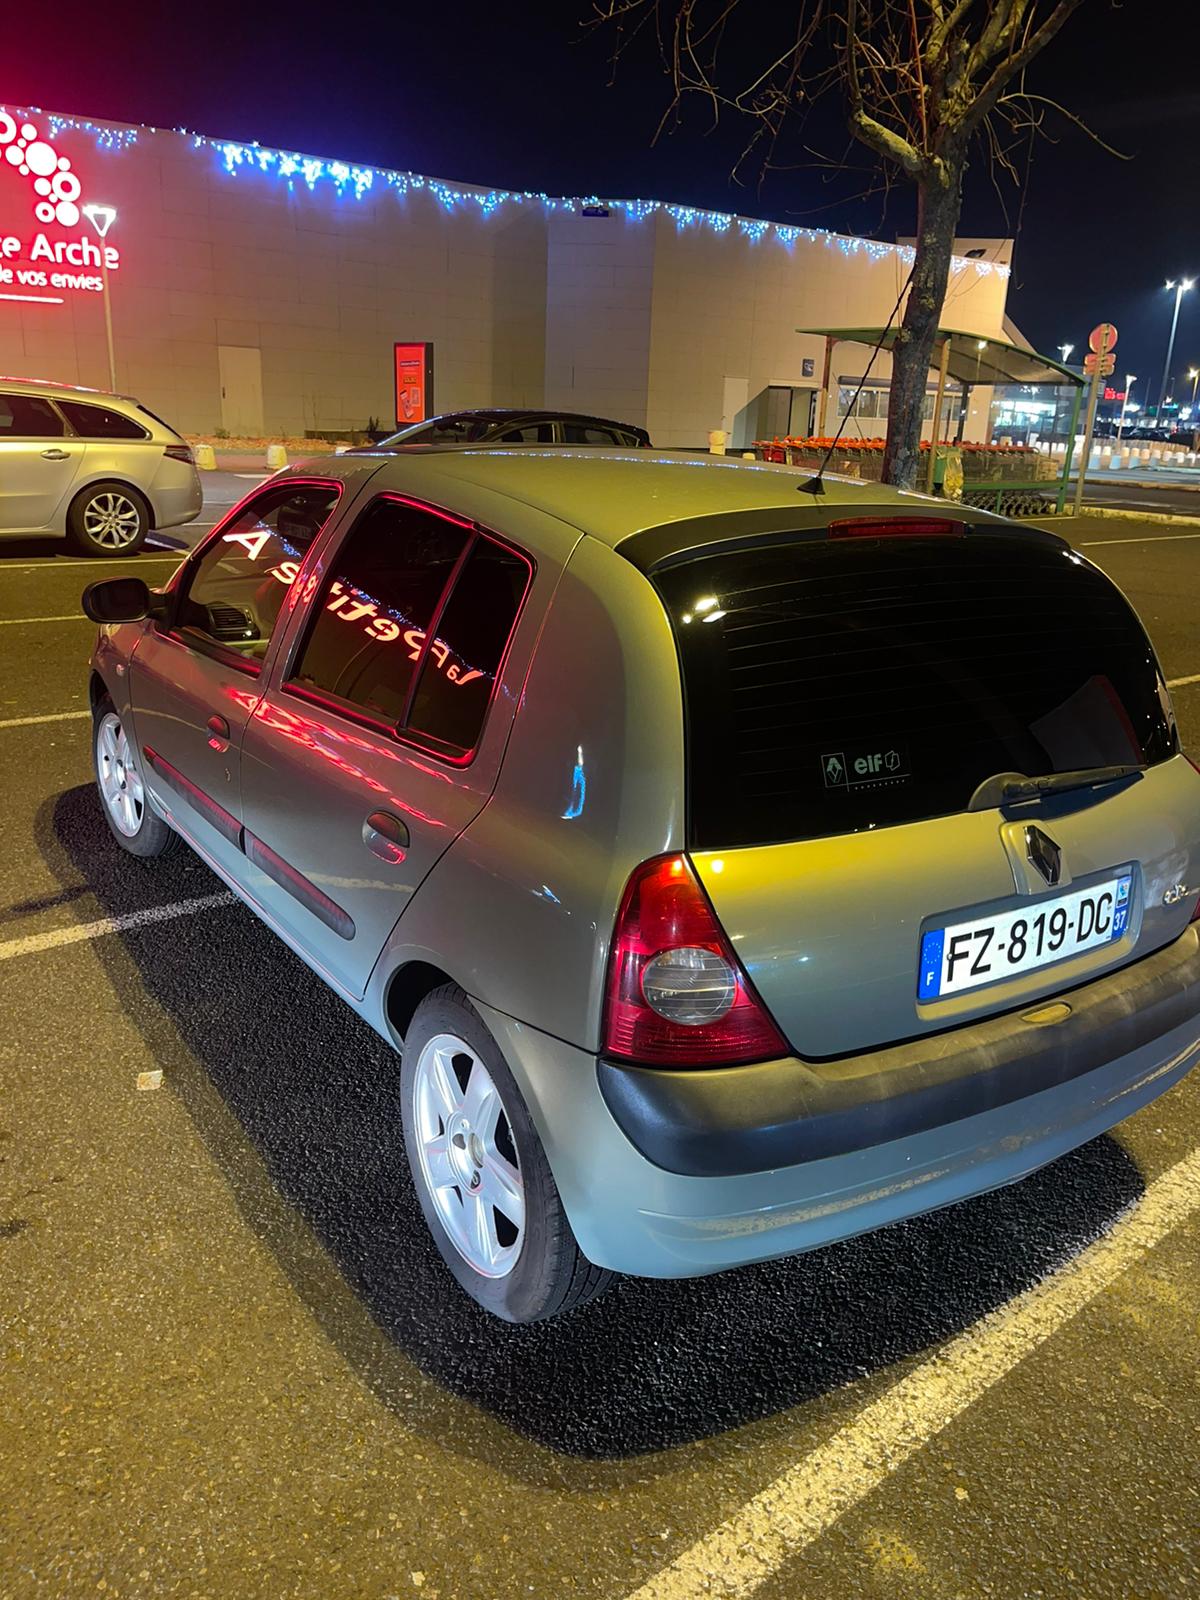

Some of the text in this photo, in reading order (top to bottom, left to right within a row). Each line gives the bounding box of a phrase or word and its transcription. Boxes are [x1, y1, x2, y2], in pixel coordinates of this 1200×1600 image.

[31, 234, 119, 269] Arche
[16, 270, 47, 286] vos
[51, 274, 104, 291] envies
[854, 753, 883, 774] elf
[925, 892, 1127, 986] F FZ-819-DC 37
